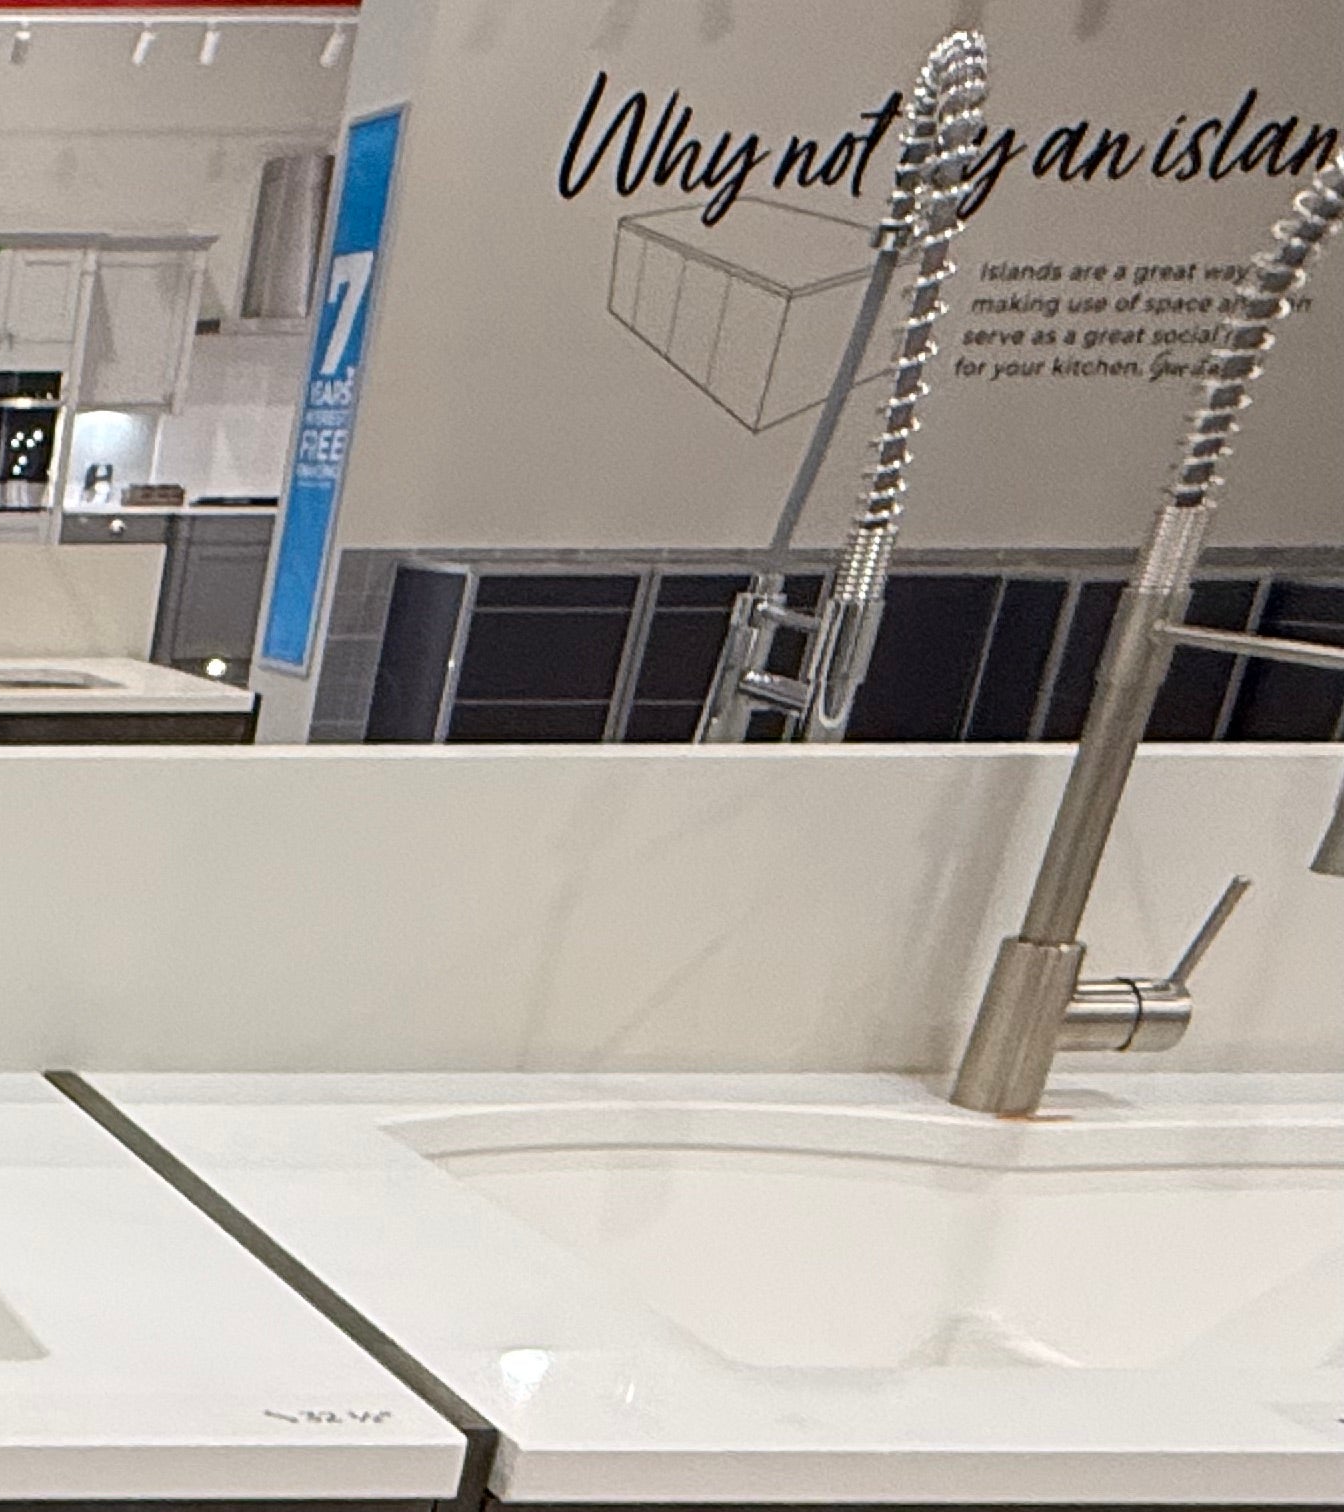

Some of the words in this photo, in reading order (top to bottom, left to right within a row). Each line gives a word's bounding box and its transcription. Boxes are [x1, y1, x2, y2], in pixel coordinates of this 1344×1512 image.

[558, 70, 771, 227] Why
[772, 90, 904, 198] not
[1031, 120, 1146, 182] an
[1149, 86, 1340, 183] islan
[979, 260, 1063, 283] Islands
[1068, 265, 1108, 283] are
[1113, 266, 1127, 282] a
[1132, 262, 1198, 286] great
[1204, 264, 1251, 286] way
[320, 250, 374, 376] 7
[970, 292, 1061, 318] making
[1068, 298, 1109, 314] use
[1114, 291, 1141, 314] of
[1143, 298, 1210, 319] space
[962, 329, 1025, 347] serve
[1031, 329, 1057, 346] as
[1062, 330, 1076, 346] a
[1083, 324, 1147, 350] great
[1150, 323, 1220, 346] social
[953, 354, 988, 378] for
[990, 361, 1045, 382] your
[1051, 353, 1144, 378] kitchen.
